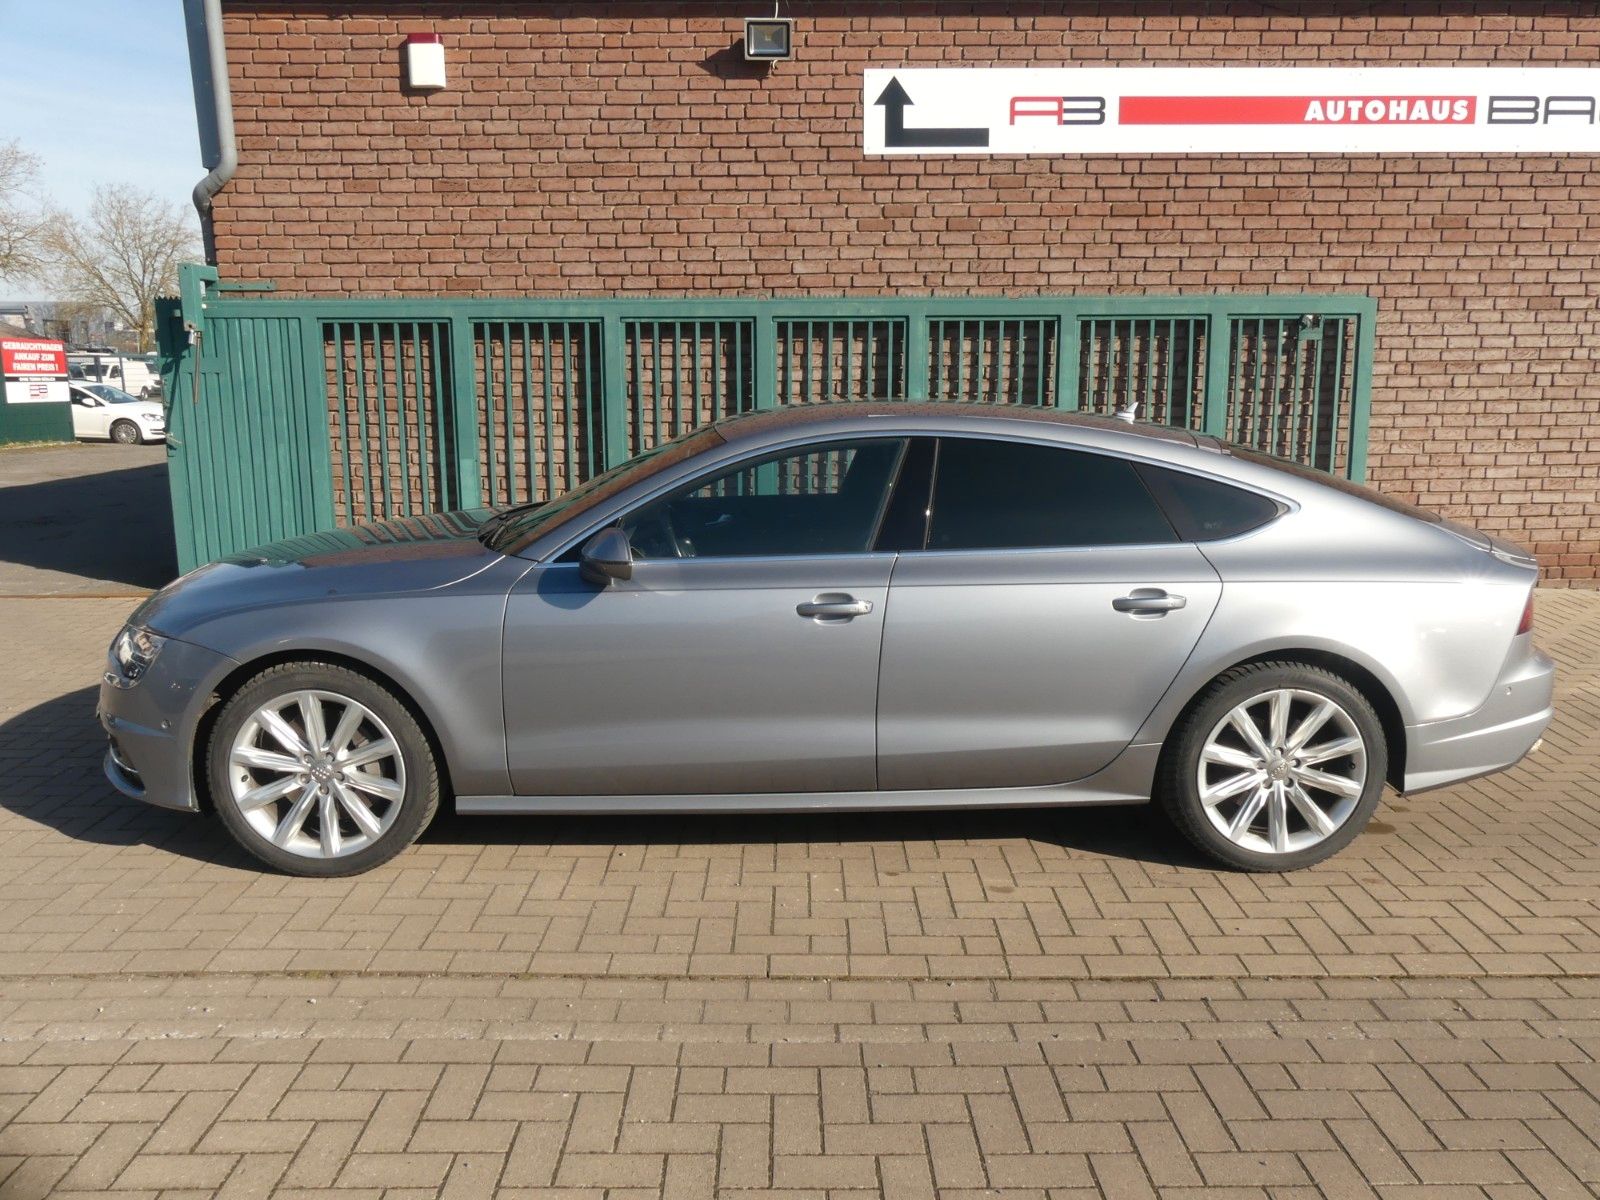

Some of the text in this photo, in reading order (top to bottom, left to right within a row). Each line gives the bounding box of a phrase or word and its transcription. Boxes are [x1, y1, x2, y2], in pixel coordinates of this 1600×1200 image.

[1009, 96, 1600, 125] AB AUTOHAUS BA
[2, 341, 63, 352] GEBRAUCHTWAGEN
[14, 352, 55, 361] ANKAUF ZUM
